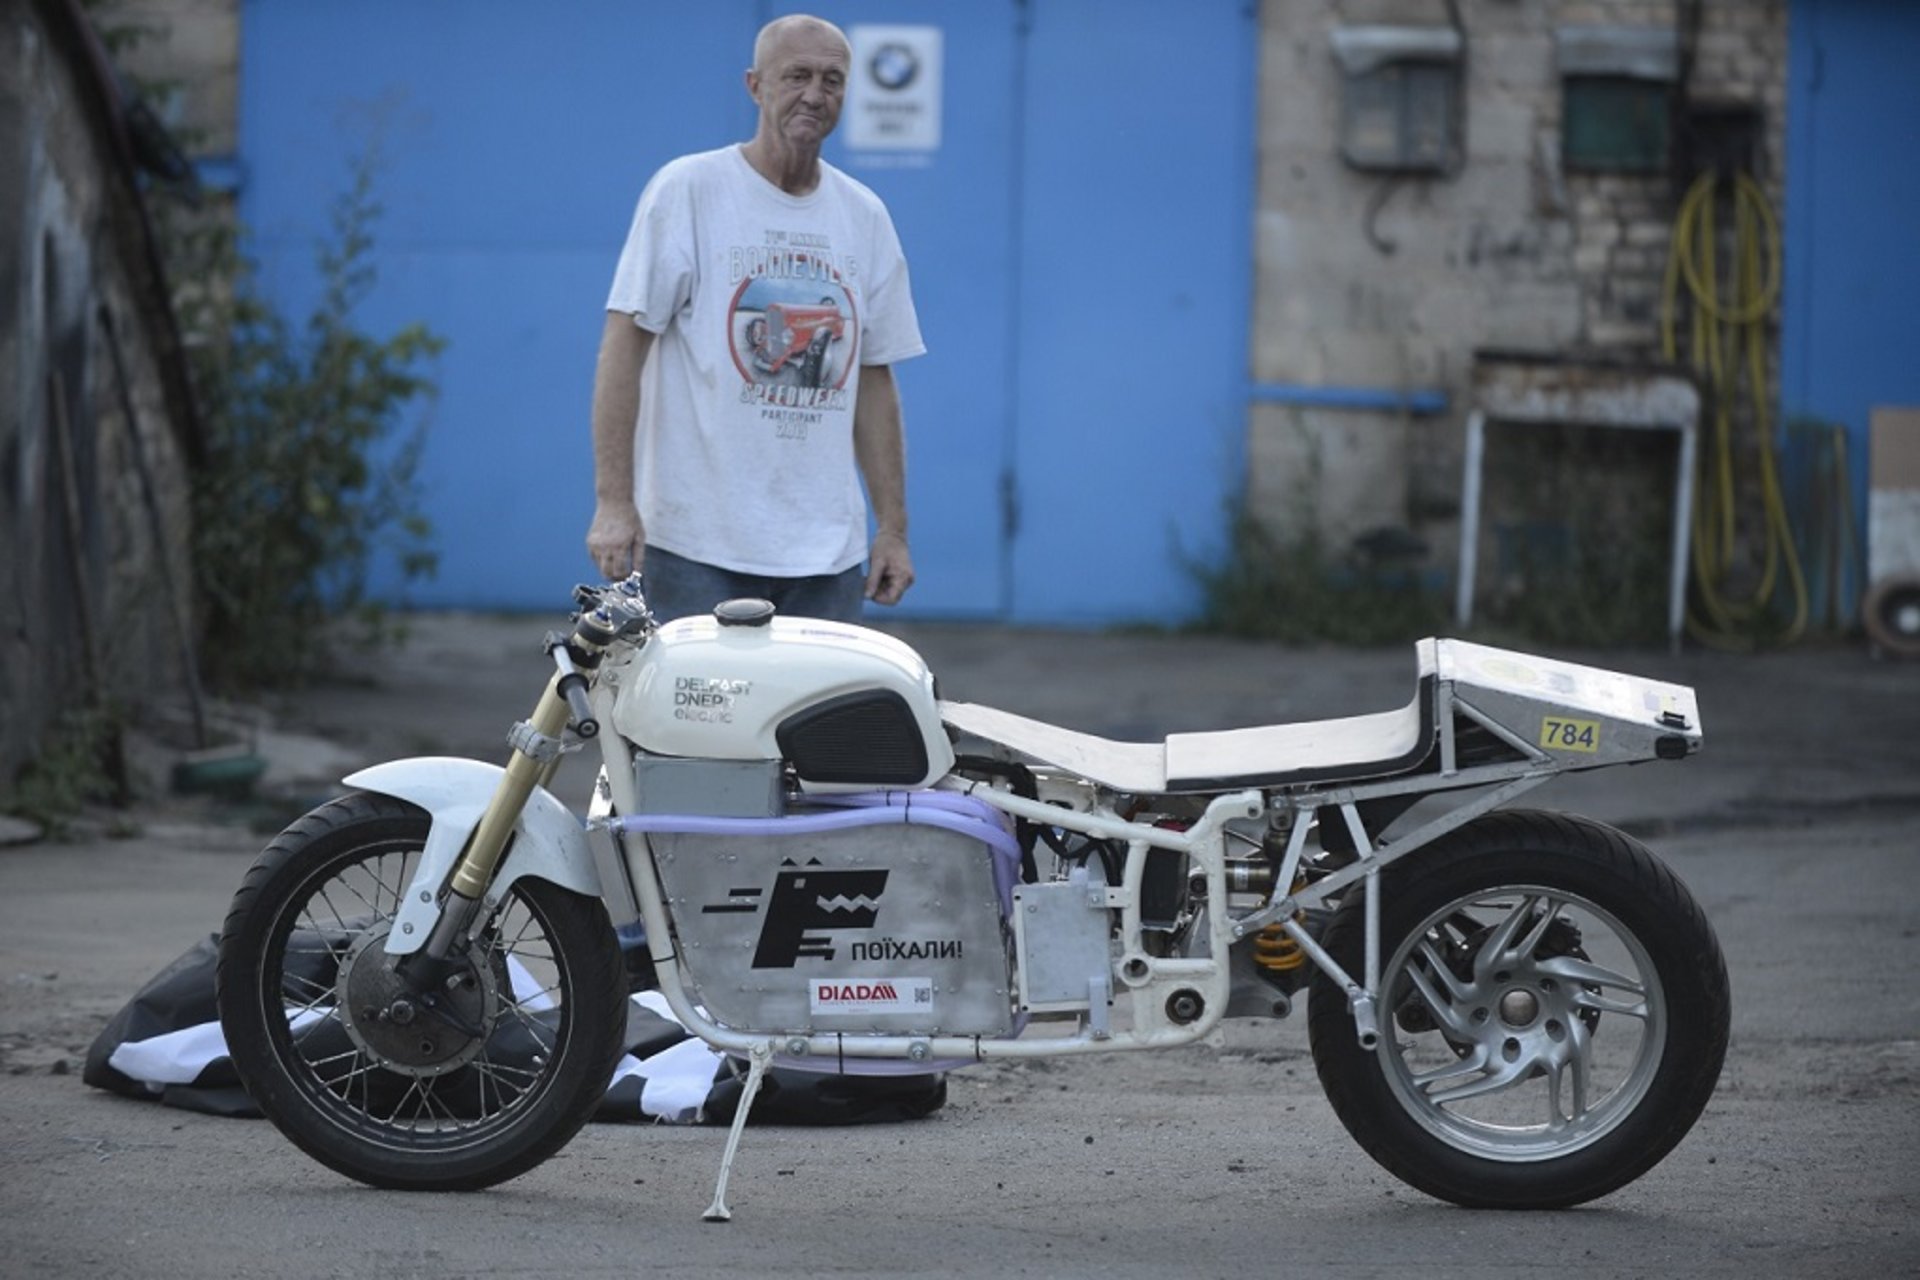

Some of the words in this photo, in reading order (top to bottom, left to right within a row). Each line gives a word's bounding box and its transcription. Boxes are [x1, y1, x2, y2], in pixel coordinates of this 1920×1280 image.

[740, 383, 847, 411] SPEEDWEEK
[761, 409, 823, 425] PARTICIPANT
[675, 677, 753, 695] DELFAST
[1546, 721, 1594, 748] 784
[851, 937, 963, 960] ПОЇХАЛИ!
